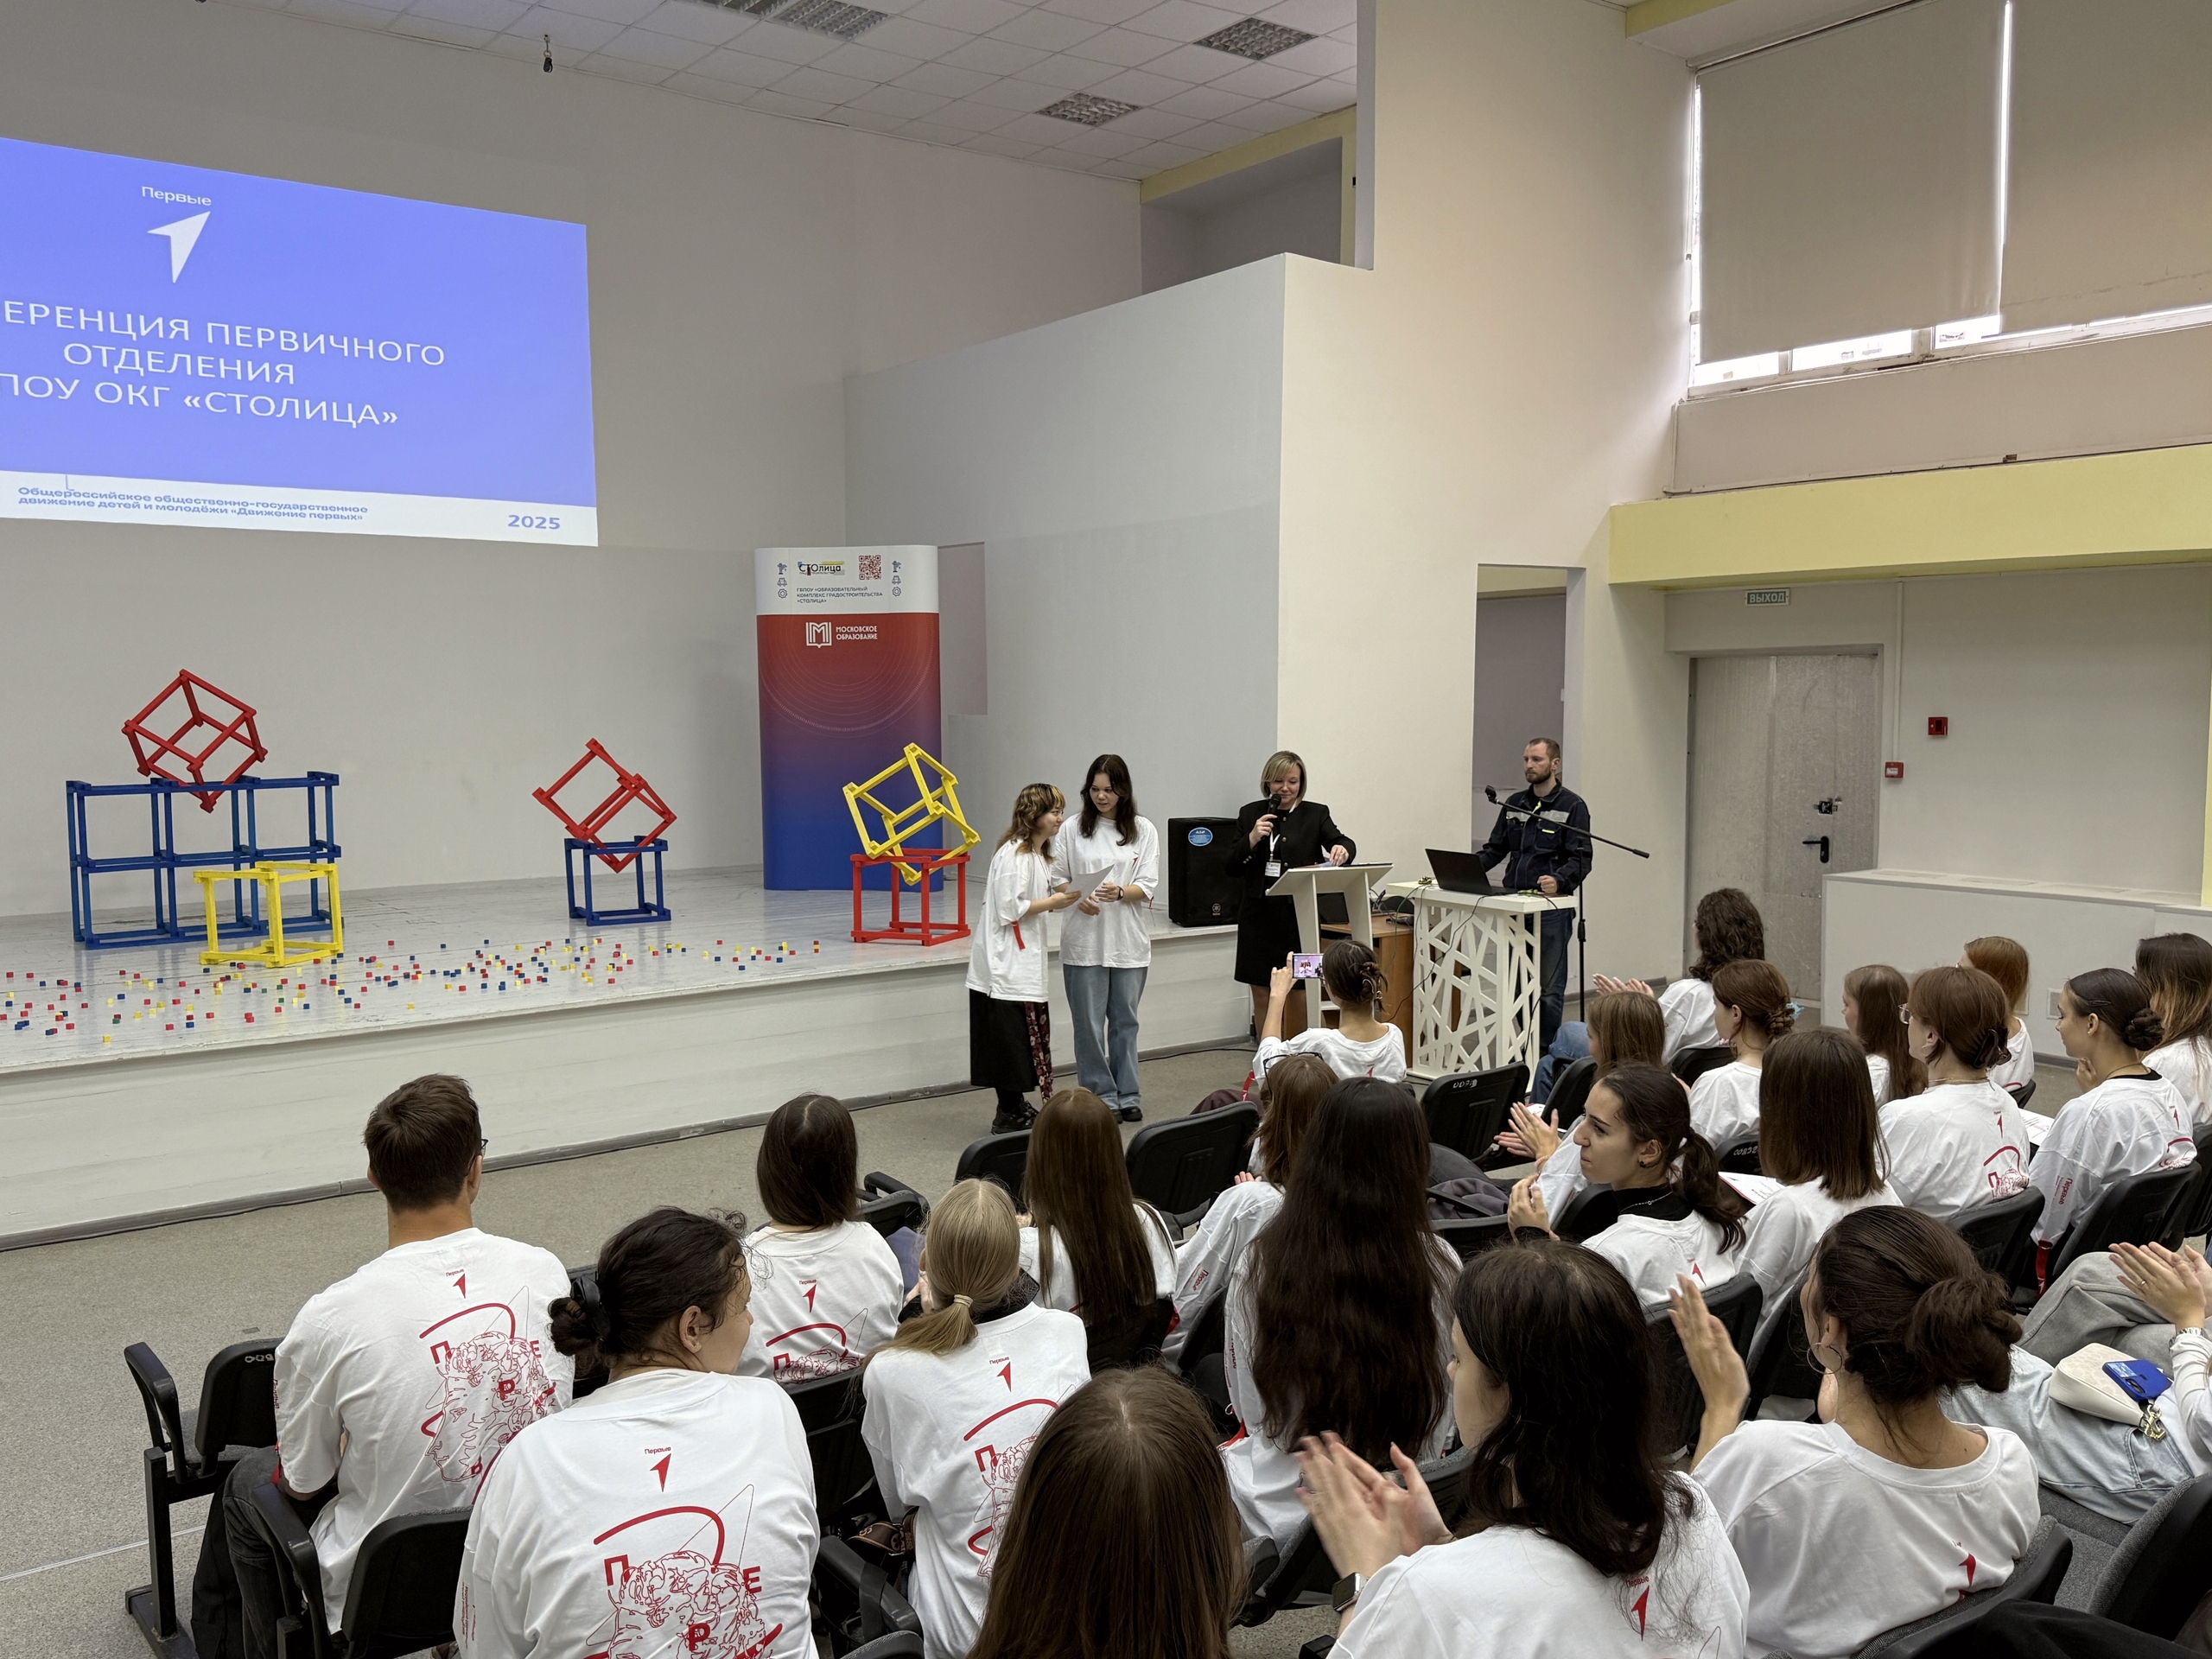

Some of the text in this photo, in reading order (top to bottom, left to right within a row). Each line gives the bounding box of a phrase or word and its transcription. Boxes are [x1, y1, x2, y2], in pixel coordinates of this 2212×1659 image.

[142, 186, 212, 207] Первые
[3, 300, 445, 366] ЕРЕНЦИЯ ПЕРВИЧНОГО
[63, 342, 295, 385] ОТДЕЛЕНИЯ
[94, 381, 170, 408] ОКГ
[183, 391, 398, 429] «СТОЛИЦА»
[18, 486, 369, 513] Общероссийское общественно-государственное
[18, 497, 95, 508] движение
[98, 501, 141, 510] детей
[156, 504, 228, 515] молодёжи
[231, 506, 307, 518] «Движение
[309, 512, 363, 520] первых»
[508, 514, 561, 530] 2025
[1749, 593, 1785, 603] ВЫХОД
